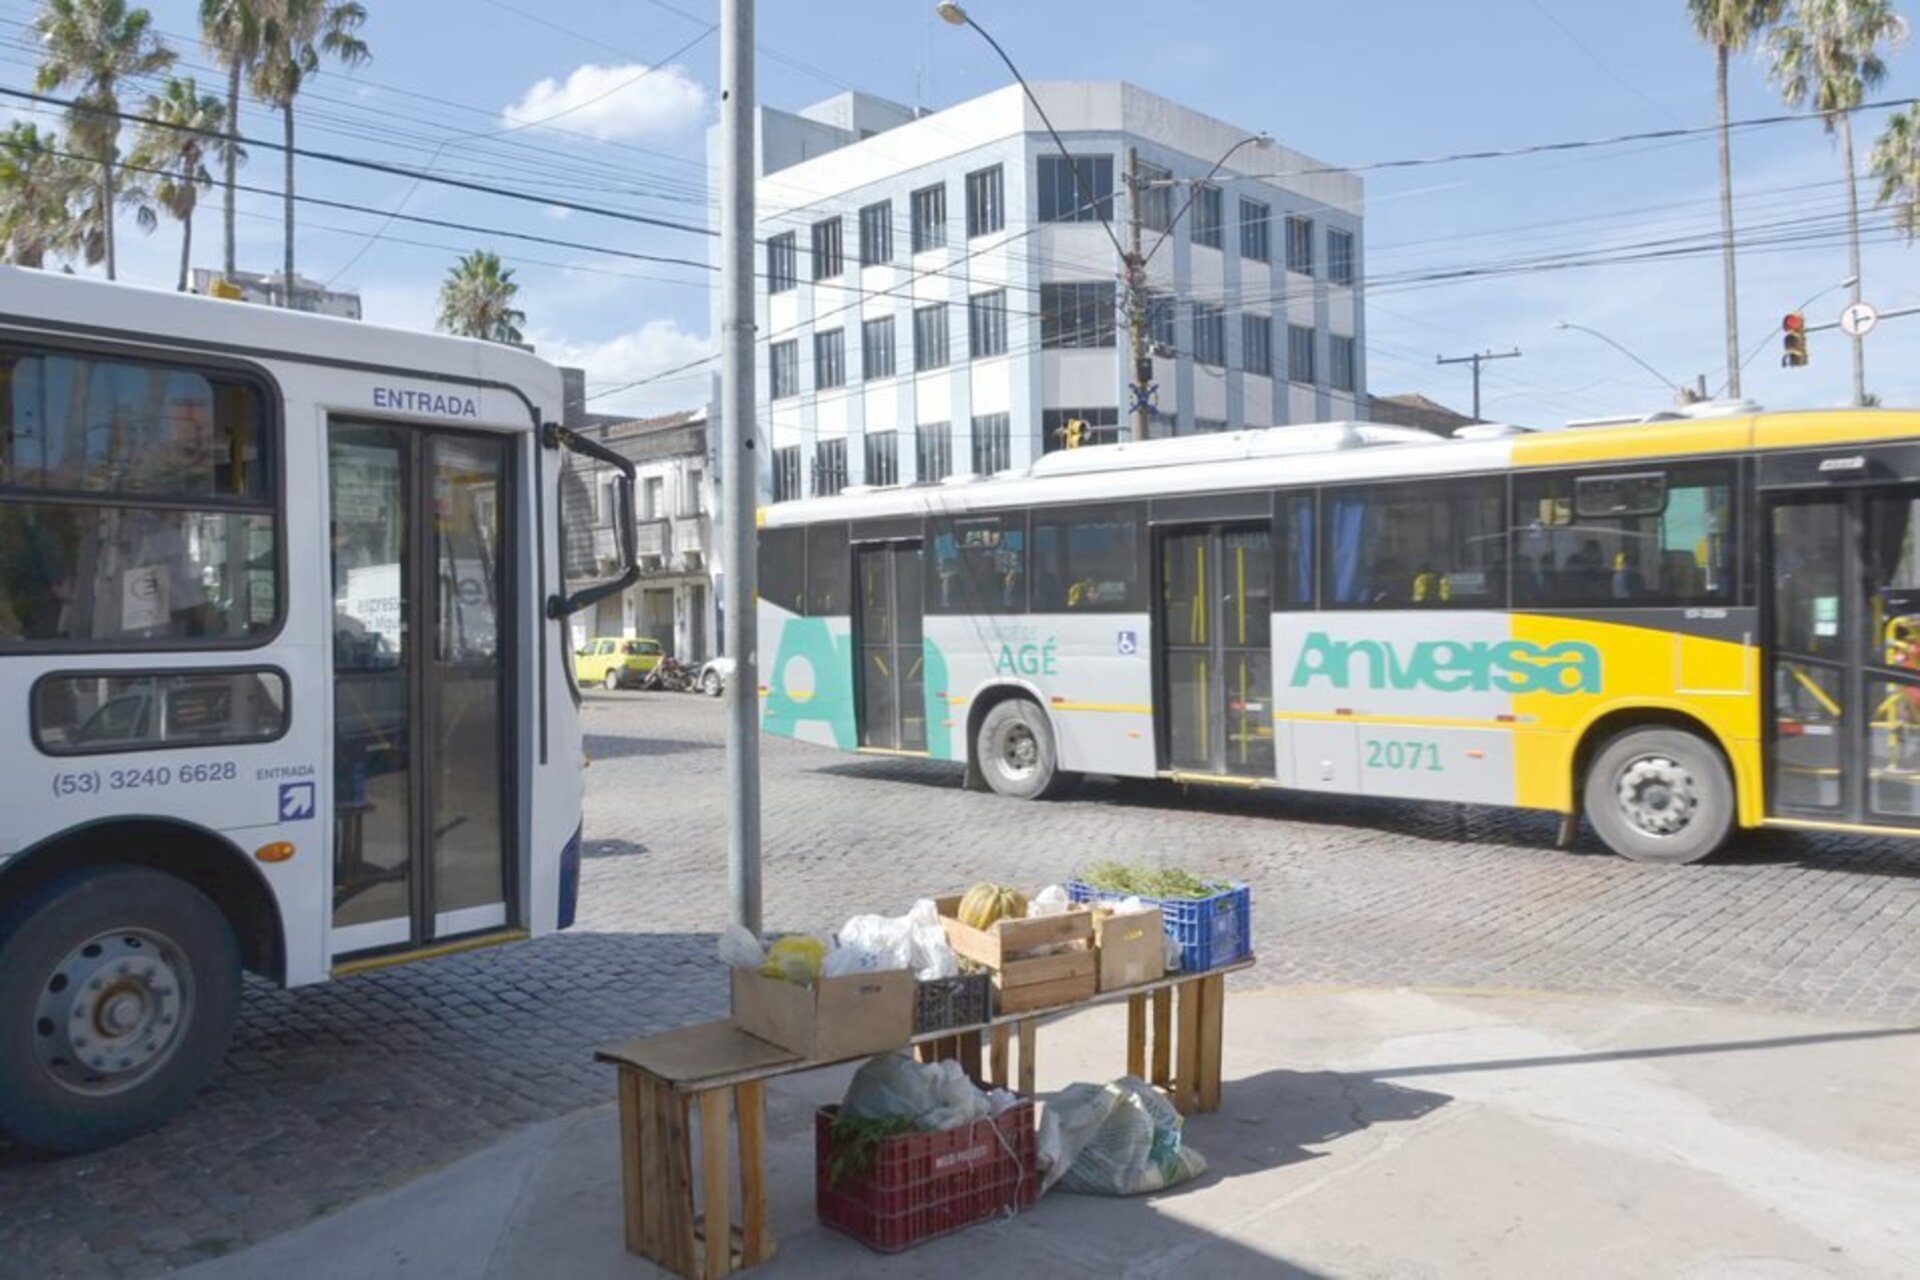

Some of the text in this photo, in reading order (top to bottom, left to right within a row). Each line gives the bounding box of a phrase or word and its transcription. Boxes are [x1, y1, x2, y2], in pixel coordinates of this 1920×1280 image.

[373, 387, 477, 417] ENTRADA
[1290, 631, 1604, 695] Anversa
[1365, 739, 1444, 772] 2071
[52, 761, 237, 797] (53) 3240 6628
[256, 764, 315, 781] ENTRADA
